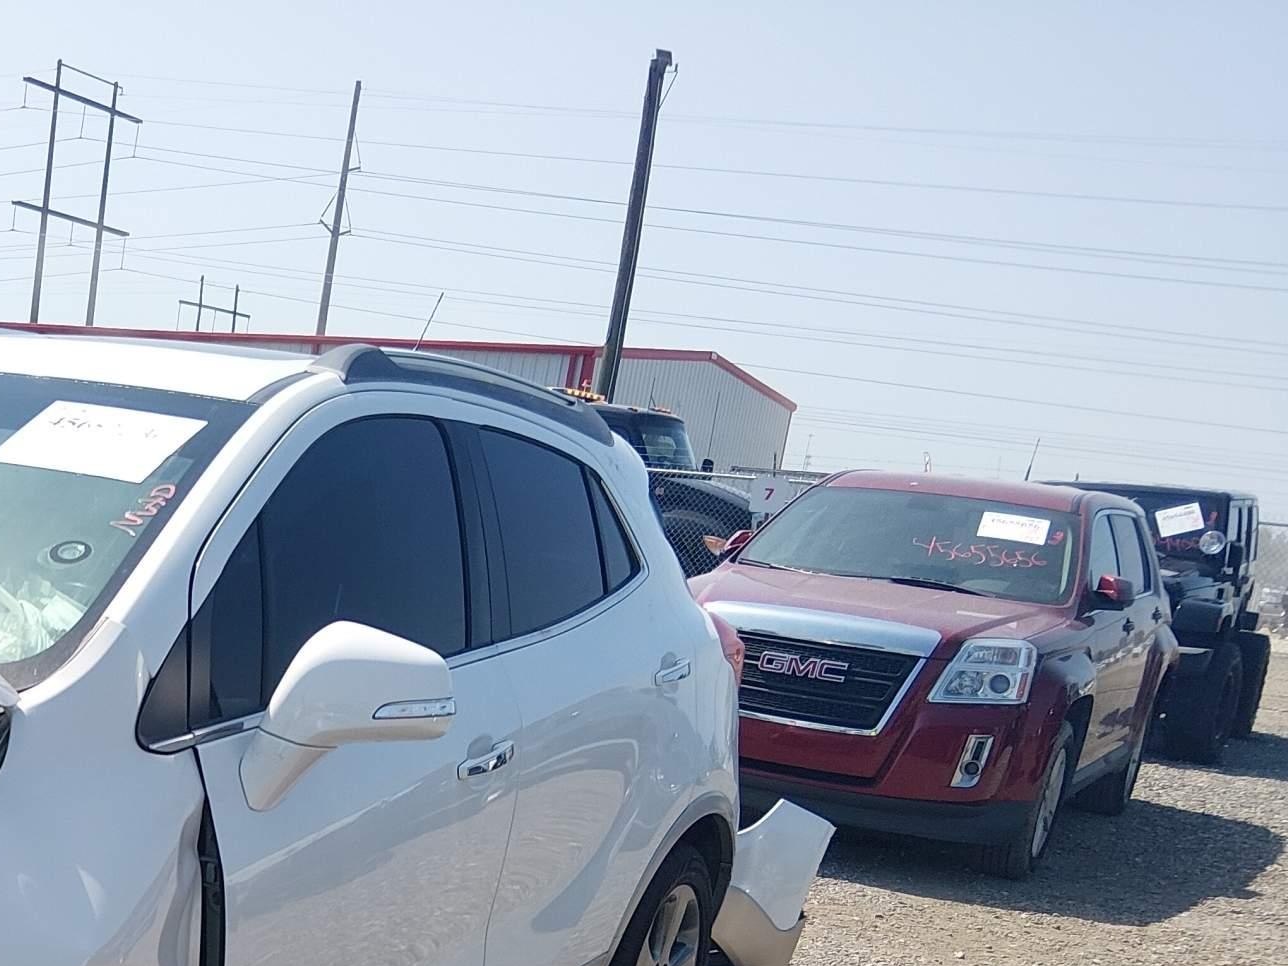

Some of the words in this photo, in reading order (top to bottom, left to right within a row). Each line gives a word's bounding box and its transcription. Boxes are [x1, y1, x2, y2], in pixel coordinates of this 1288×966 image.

[765, 488, 775, 500] 7
[912, 535, 1048, 568] 45655656
[758, 651, 849, 683] GMC
